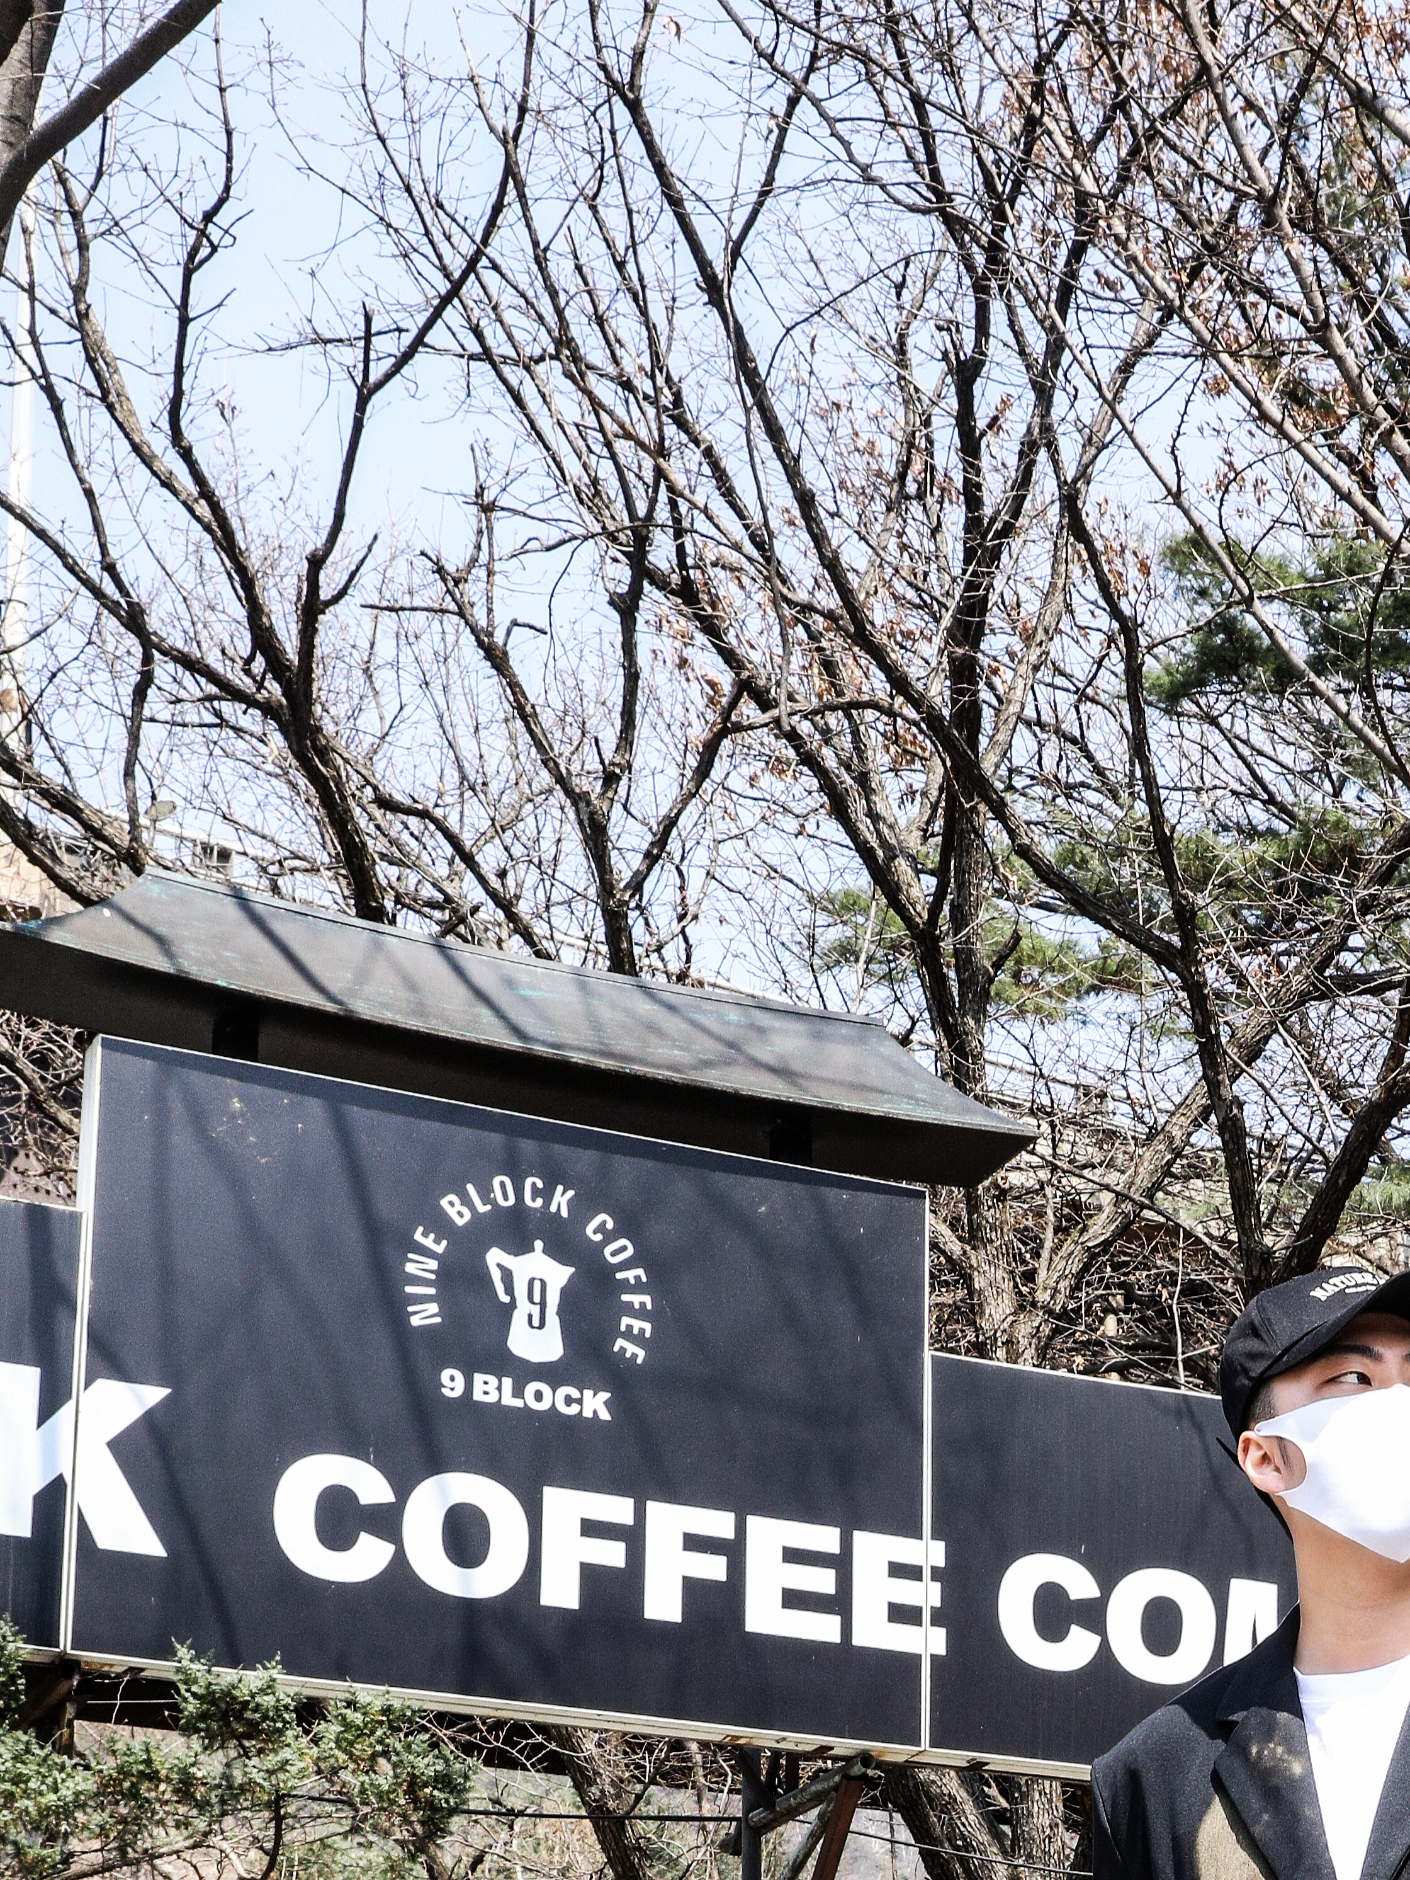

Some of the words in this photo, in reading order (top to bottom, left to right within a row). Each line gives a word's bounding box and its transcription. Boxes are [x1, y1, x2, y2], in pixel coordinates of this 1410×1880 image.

[404, 1225, 448, 1326] NINE
[439, 1175, 576, 1227] BLOCK
[585, 1212, 652, 1365] COFFEE
[527, 1277, 548, 1331] 9
[440, 1367, 466, 1398] 9
[472, 1372, 612, 1421] BLOCK
[0, 1361, 173, 1557] K
[273, 1453, 948, 1655] COFFEE
